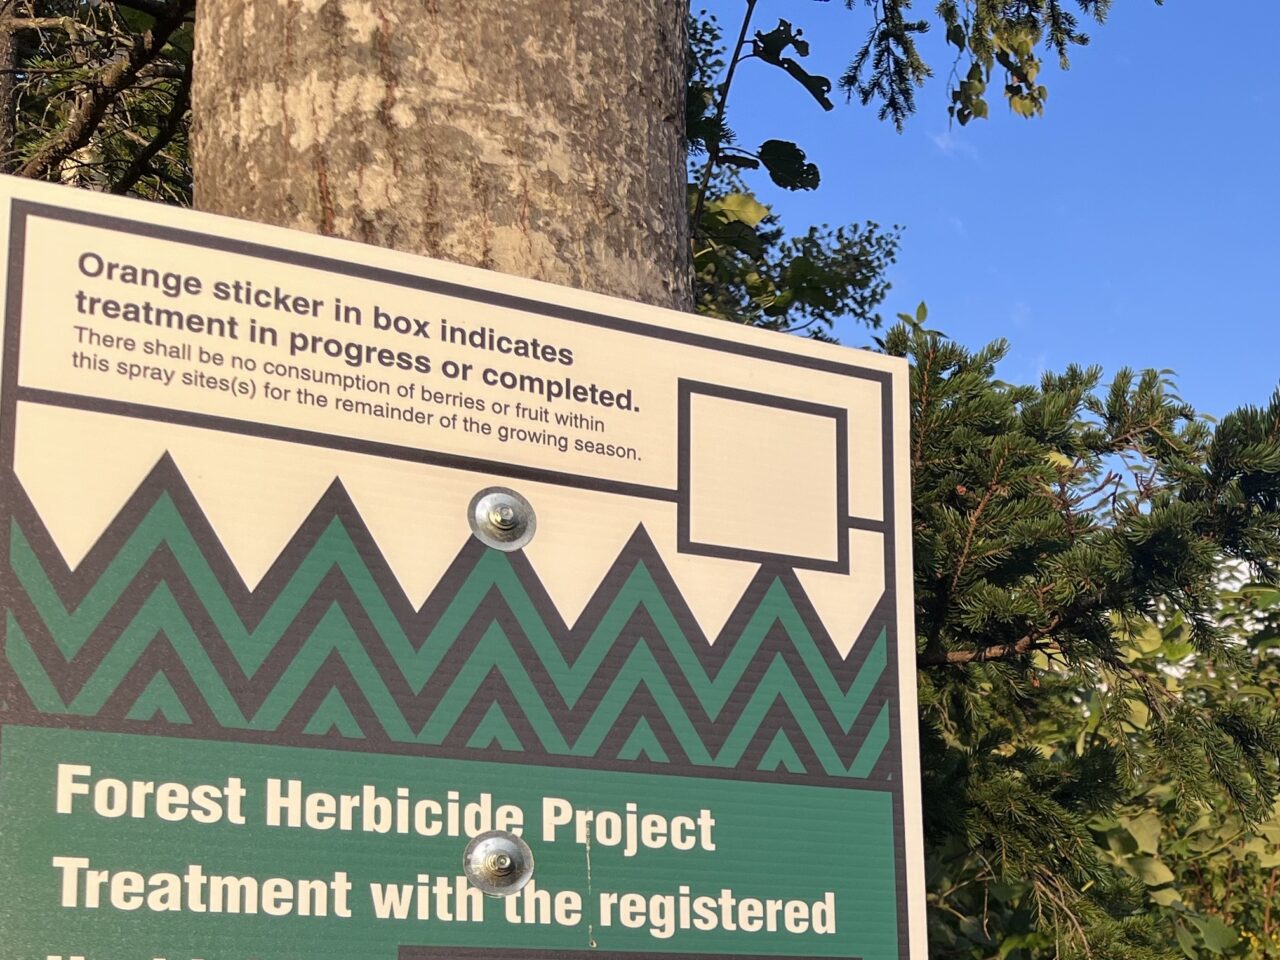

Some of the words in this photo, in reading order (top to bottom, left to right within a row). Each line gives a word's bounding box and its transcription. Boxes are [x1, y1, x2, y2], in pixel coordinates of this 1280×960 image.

[74, 291, 238, 340] treatment
[250, 319, 277, 346] in
[289, 332, 431, 374] progress
[442, 361, 472, 380] or
[483, 368, 641, 413] completed.
[79, 253, 201, 297] Orange
[213, 281, 324, 317] sticker
[335, 298, 361, 325] in
[374, 306, 430, 338] box
[441, 320, 573, 365] indicates
[72, 352, 109, 372] this
[117, 362, 175, 386] spray
[182, 372, 256, 399] sites(s)
[264, 382, 291, 401] for
[297, 389, 327, 407] the
[336, 398, 434, 425] remainder
[440, 414, 457, 429] of
[463, 417, 491, 435] the
[498, 424, 568, 452] growing
[575, 439, 642, 461] season.
[74, 326, 135, 351] There
[143, 339, 191, 360] shall
[199, 347, 224, 366] be
[232, 356, 256, 371] no
[264, 362, 389, 394] consumption
[397, 384, 415, 399] of
[422, 386, 485, 411] berries
[492, 402, 510, 415] or
[516, 403, 549, 423] fruit
[555, 413, 604, 432] within
[57, 764, 246, 824] Forest
[267, 779, 524, 838] Herbicide
[543, 797, 715, 856] Project
[53, 857, 351, 917] Treatment
[370, 874, 483, 921] with
[505, 879, 582, 926] the
[600, 889, 835, 938] registered
